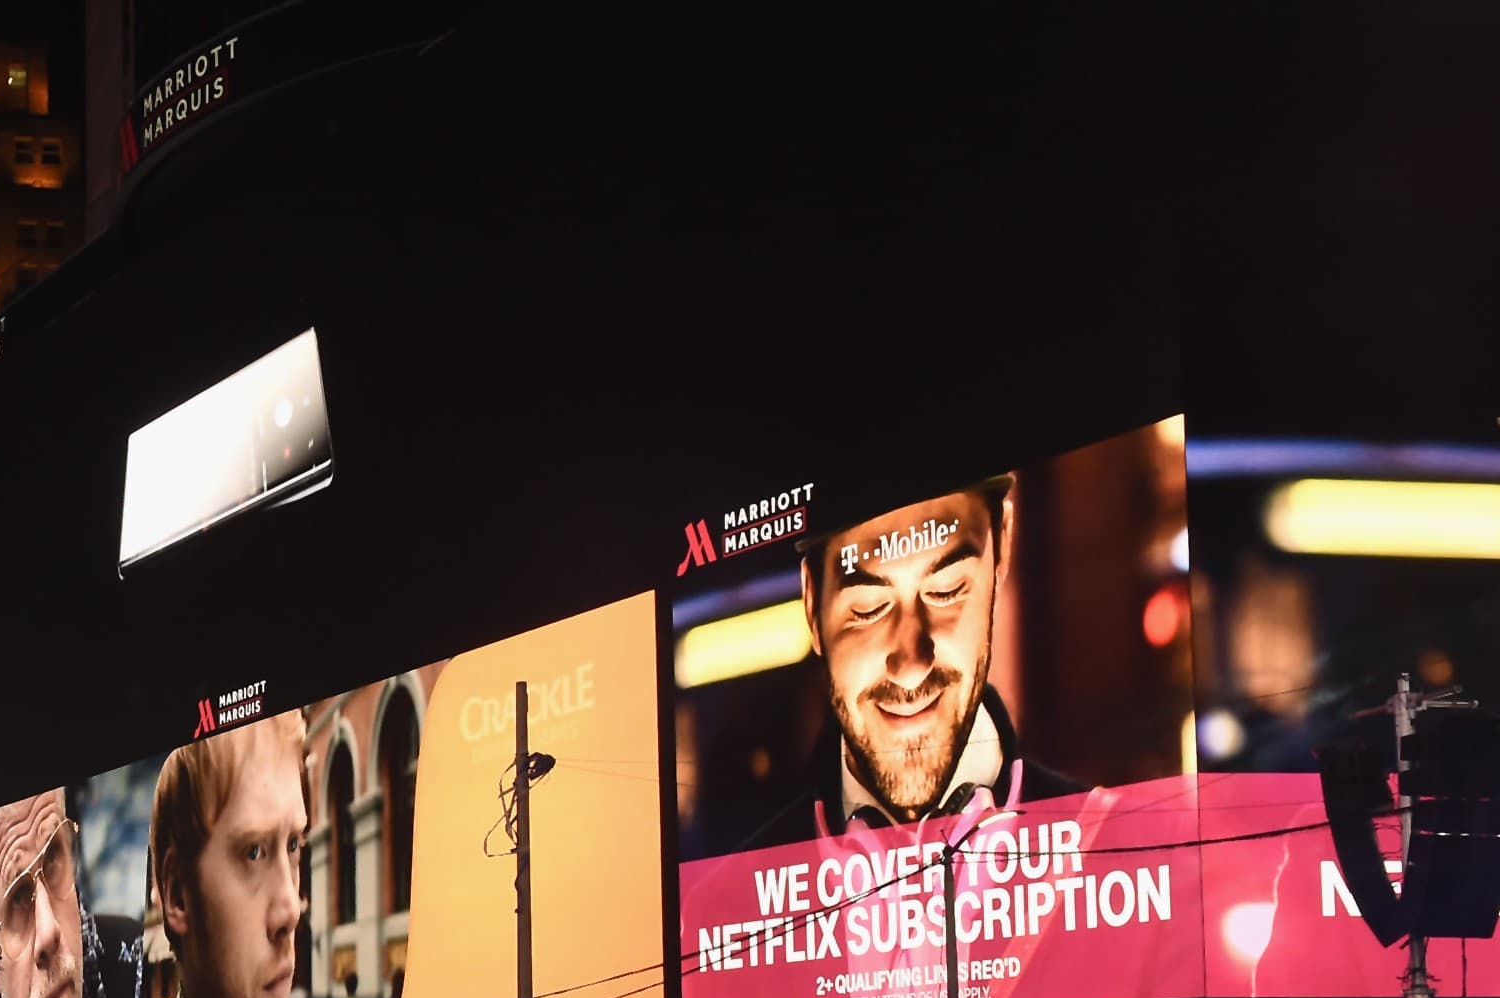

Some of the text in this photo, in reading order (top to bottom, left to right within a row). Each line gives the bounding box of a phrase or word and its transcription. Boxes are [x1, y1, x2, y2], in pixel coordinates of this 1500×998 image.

[144, 37, 238, 117] MARRIOTT
[144, 77, 224, 147] MARQUIS
[723, 482, 814, 530] MARRIOTT
[723, 512, 803, 554] MARQUIS
[219, 680, 267, 708] MARRIOTT
[219, 700, 261, 725] MARQUIS
[754, 820, 1084, 916] WE COVER YOUR
[698, 864, 1173, 972] NETFLIX SUBSCRIPTION
[835, 966, 921, 995] QUALIFYING
[923, 961, 969, 985] LINS
